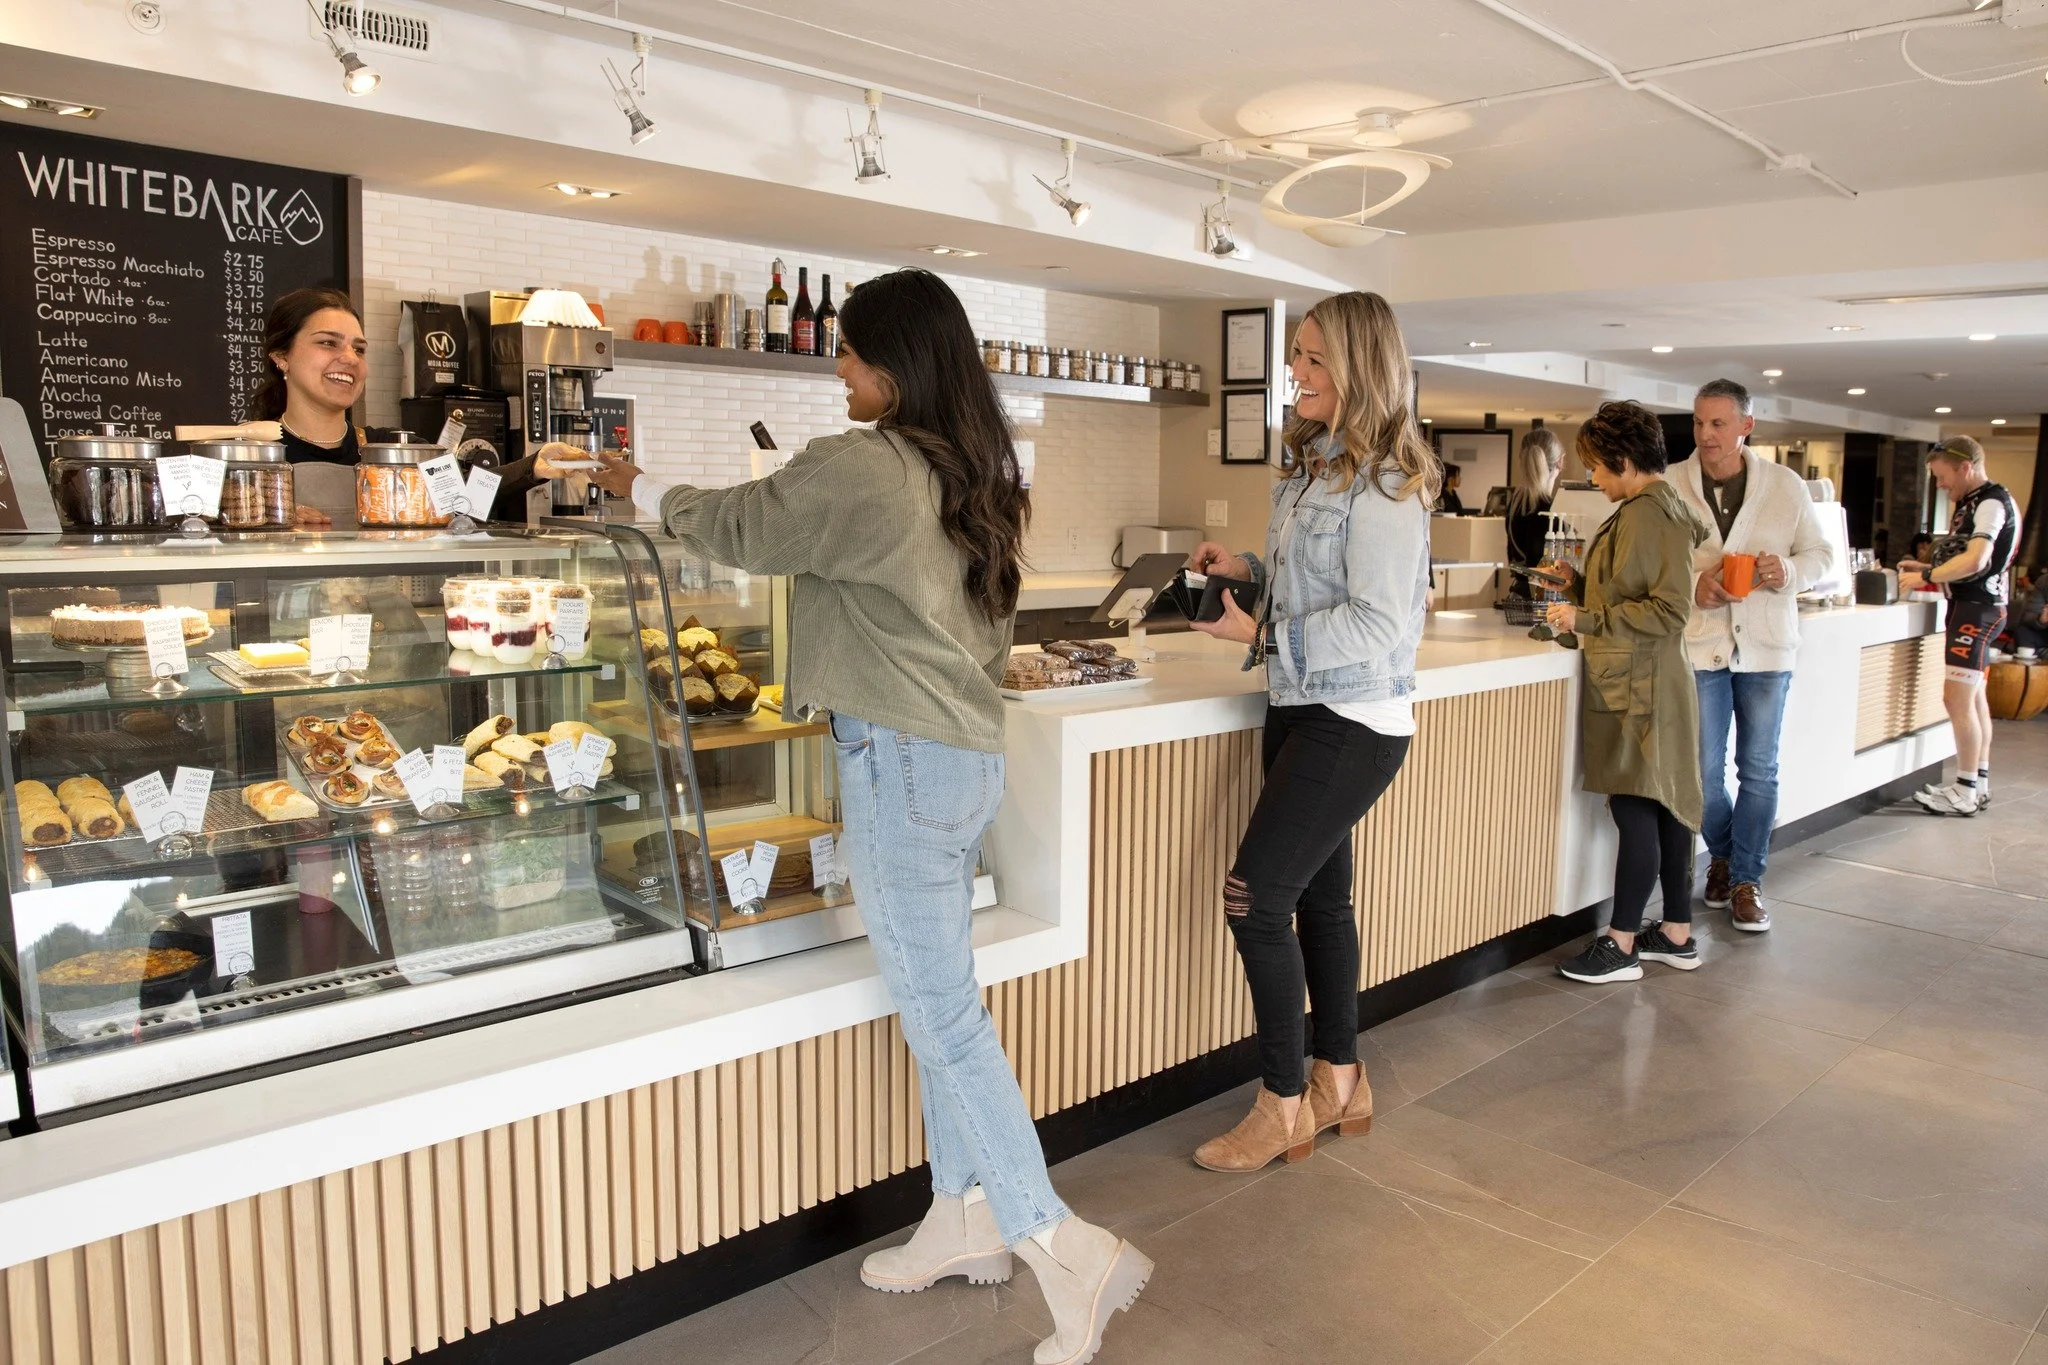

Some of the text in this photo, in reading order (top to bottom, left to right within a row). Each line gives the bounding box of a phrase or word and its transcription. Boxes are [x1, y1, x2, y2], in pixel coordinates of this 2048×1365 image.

[17, 151, 281, 242] WHITEBARK
[32, 228, 116, 253] Espresso
[236, 226, 283, 245] CAFE
[33, 247, 205, 279] Espresso Macchiato
[224, 250, 264, 269] $2.75
[34, 266, 111, 287] Cortado
[225, 266, 264, 283] $3.50
[35, 283, 76, 302] Flat
[83, 287, 134, 307] White
[226, 283, 264, 299] $3.75
[37, 303, 137, 326] Cappuccino
[226, 299, 263, 315] $4.15
[227, 316, 265, 332] $4.20
[37, 330, 88, 348] Latte
[40, 349, 128, 369] Americano
[229, 359, 264, 375] $3.50
[41, 367, 182, 388] Americano Misto
[40, 385, 102, 403] Mocha
[42, 403, 162, 421] Brewed Coffee
[594, 407, 626, 415] BUNN
[45, 423, 172, 440] Loose eaf Tea
[1951, 624, 1982, 659] AbR
[134, 778, 152, 790] PORK
[136, 784, 163, 797] FENNEL
[185, 778, 208, 786] CHEESE
[134, 789, 166, 808] SAUSAGE
[150, 799, 168, 809] ROLL
